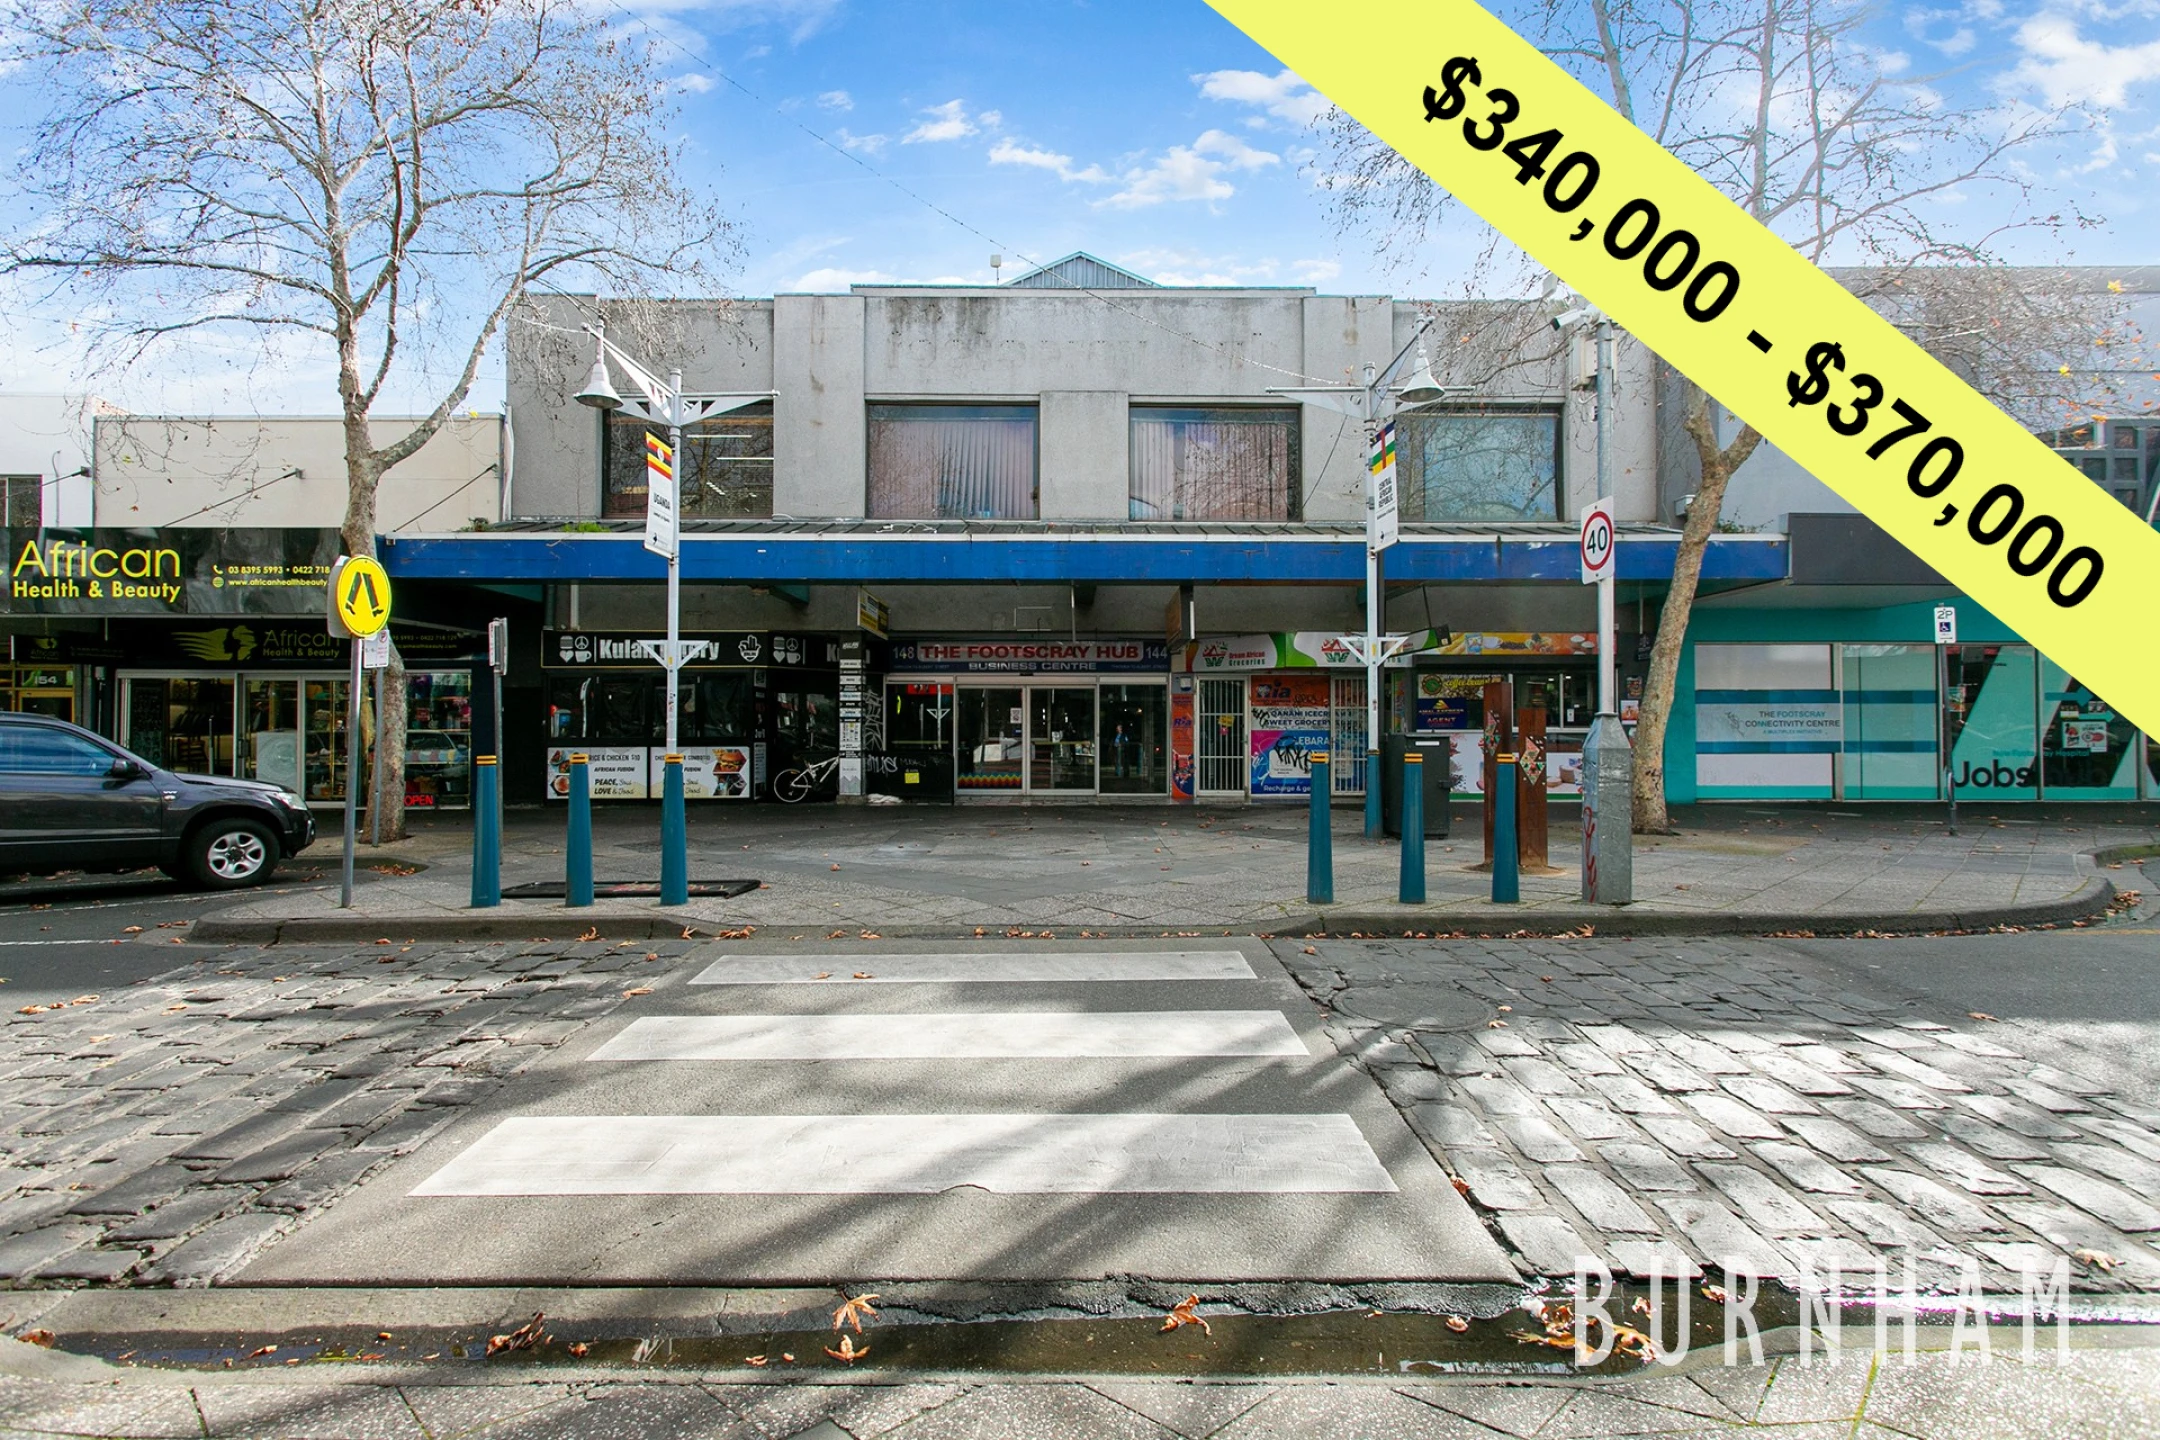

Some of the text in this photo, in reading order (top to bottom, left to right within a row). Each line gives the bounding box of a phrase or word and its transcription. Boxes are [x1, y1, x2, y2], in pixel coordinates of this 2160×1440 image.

[1586, 526, 1608, 554] 40
[12, 540, 181, 577] African
[227, 565, 331, 575] 03 8395 5993 0422 718
[13, 579, 181, 603] Health & Beauty
[1937, 610, 1953, 620] 2P
[263, 648, 340, 659] Health & Beauty
[892, 645, 915, 660] 148
[920, 645, 1139, 659] THE FOOTSCRAY HUB
[1145, 645, 1168, 660] 144
[968, 661, 1097, 671] BUSINESS CENTRE
[34, 675, 58, 685] 154
[1759, 710, 1826, 718] THE FOOTSCRAY
[1173, 716, 1191, 728] Ria
[1745, 719, 1840, 728] CONNECTIVITY CENTRE
[2012, 750, 2053, 758] Footsay
[2055, 750, 2090, 758] Hospital
[1953, 758, 2035, 788] Jobs
[594, 787, 611, 795] LOVE
[1263, 784, 1295, 793] Recharge
[404, 795, 434, 806] OPEN
